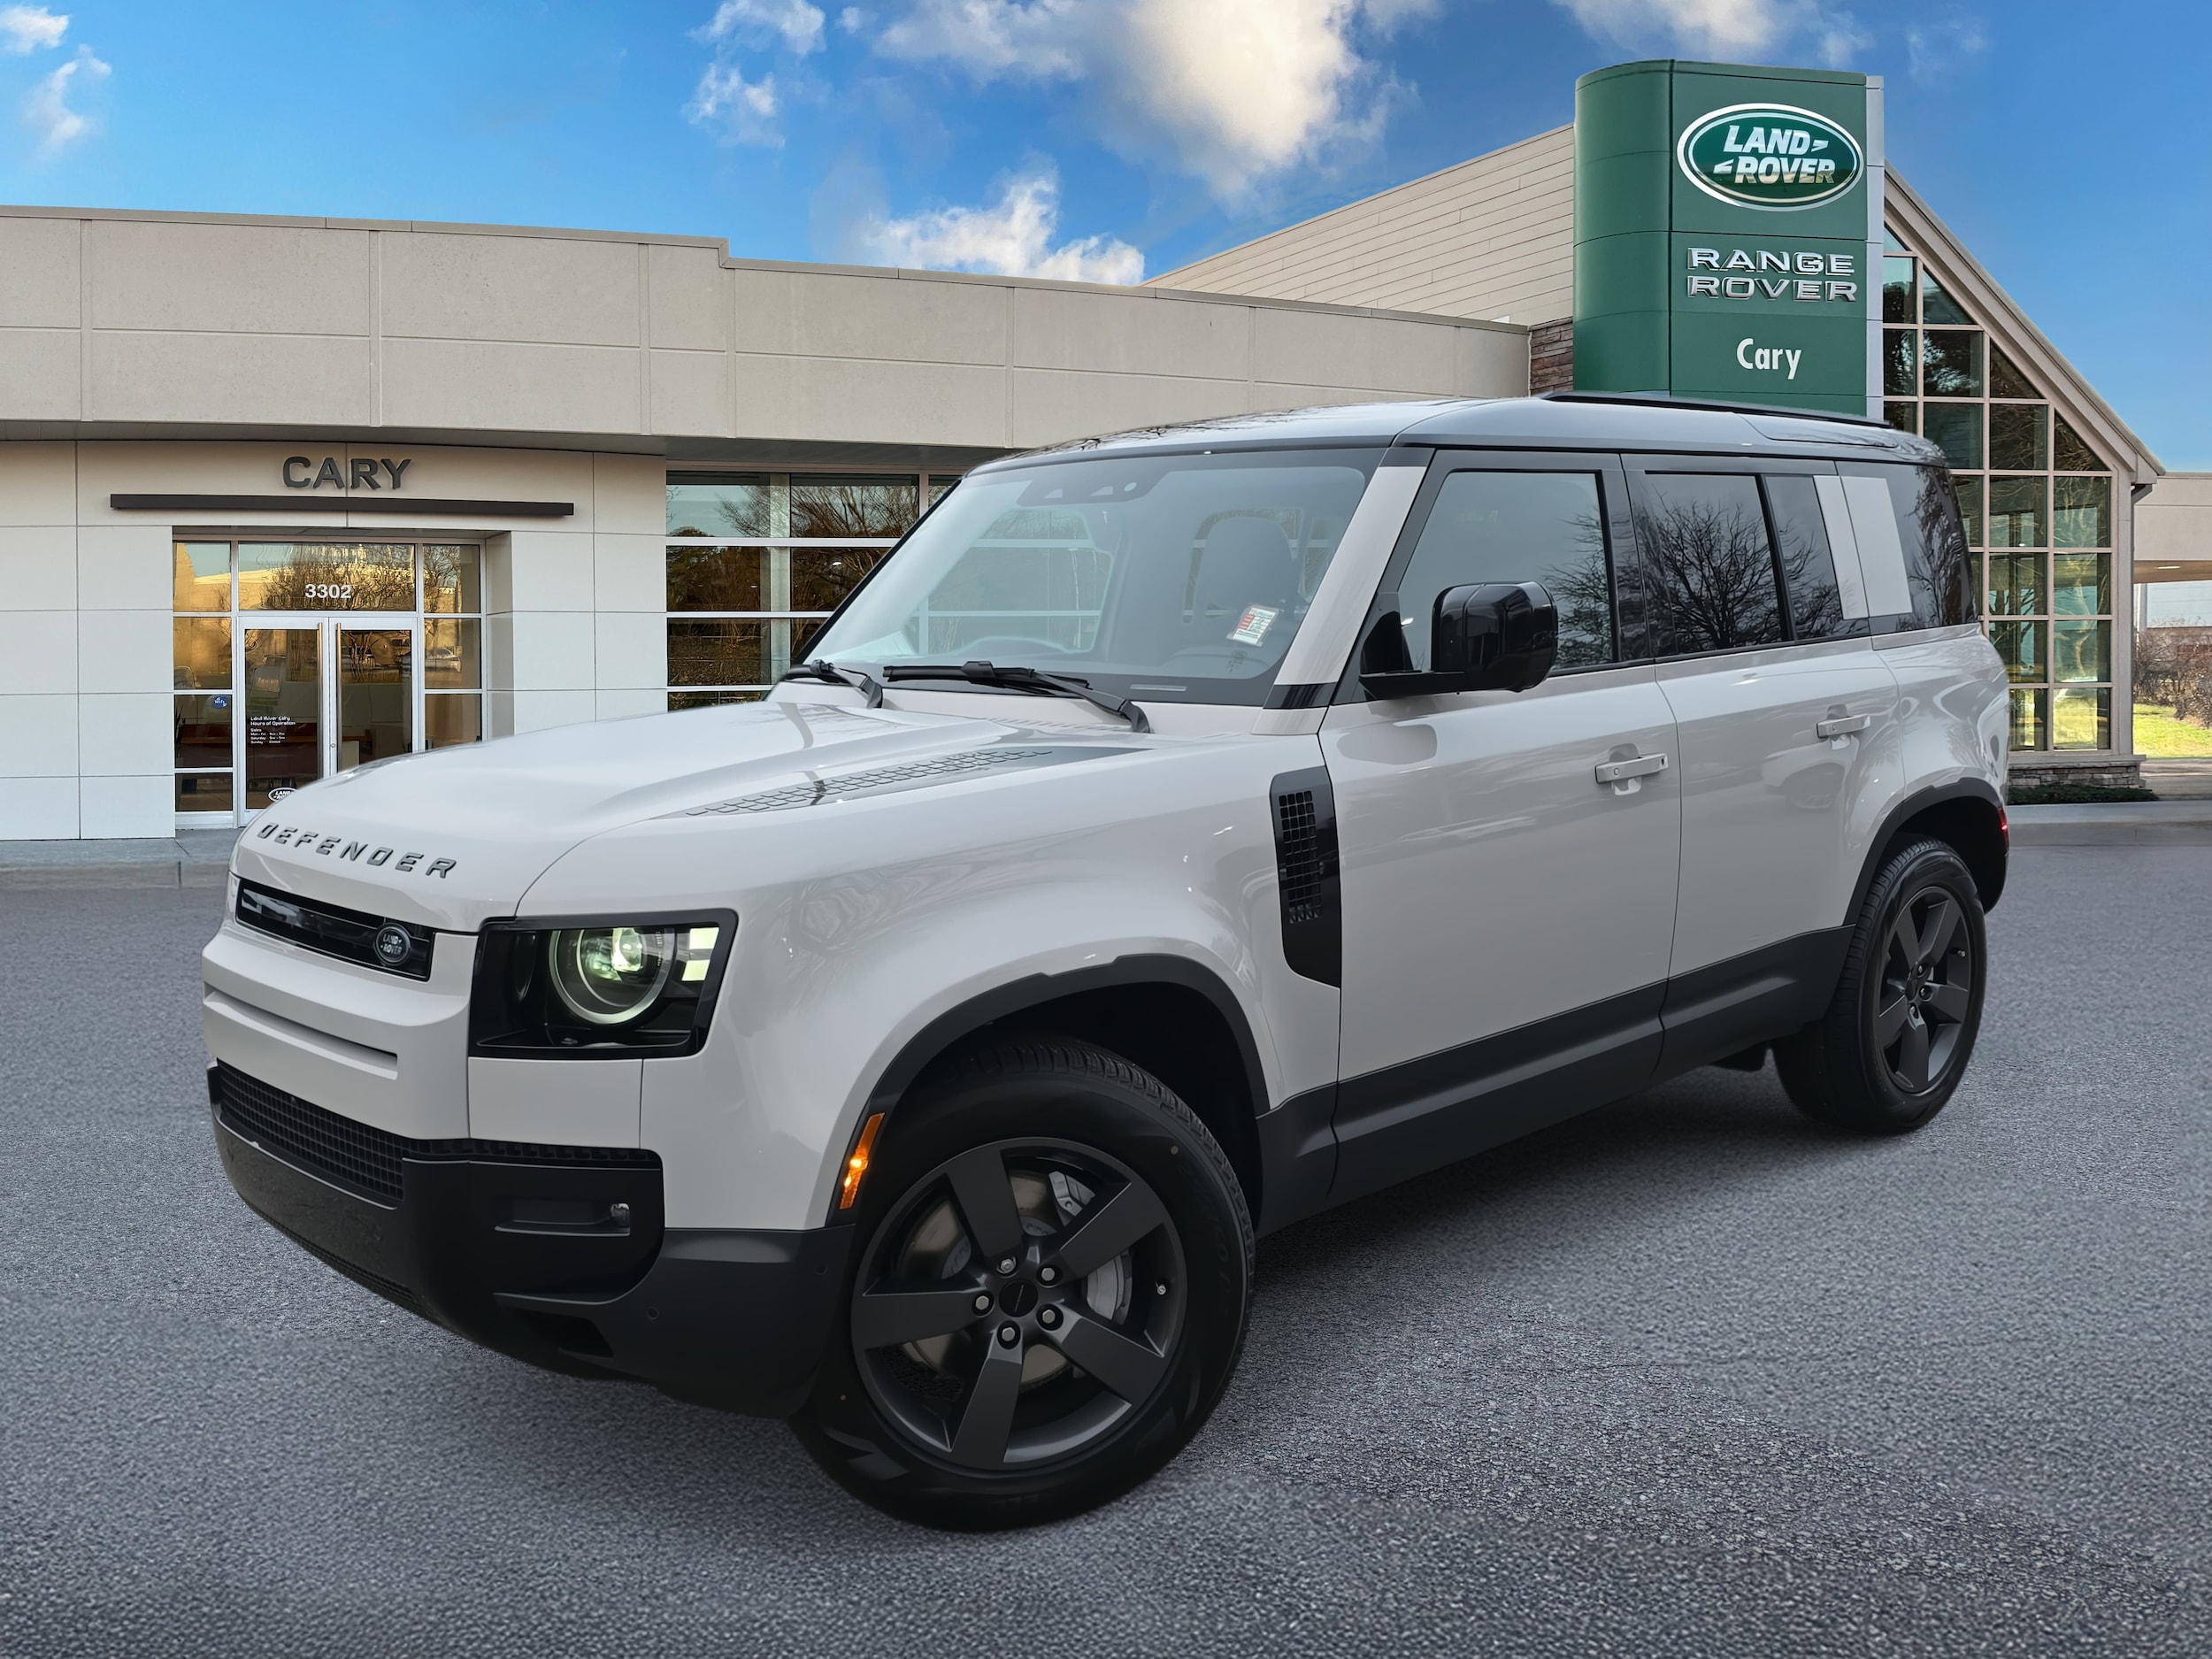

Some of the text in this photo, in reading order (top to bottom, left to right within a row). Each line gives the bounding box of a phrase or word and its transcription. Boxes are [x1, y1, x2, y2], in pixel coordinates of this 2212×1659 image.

[1724, 125, 1810, 156] LAND
[1733, 157, 1836, 184] ROVER
[1687, 247, 1856, 276] RANGE
[1686, 275, 1857, 303] ROVER
[1736, 338, 1802, 380] Cary
[282, 456, 412, 490] CARY
[304, 583, 352, 599] 3302
[257, 821, 457, 879] DEFENDER
[382, 933, 399, 945] LAND
[382, 943, 403, 955] ROVER
